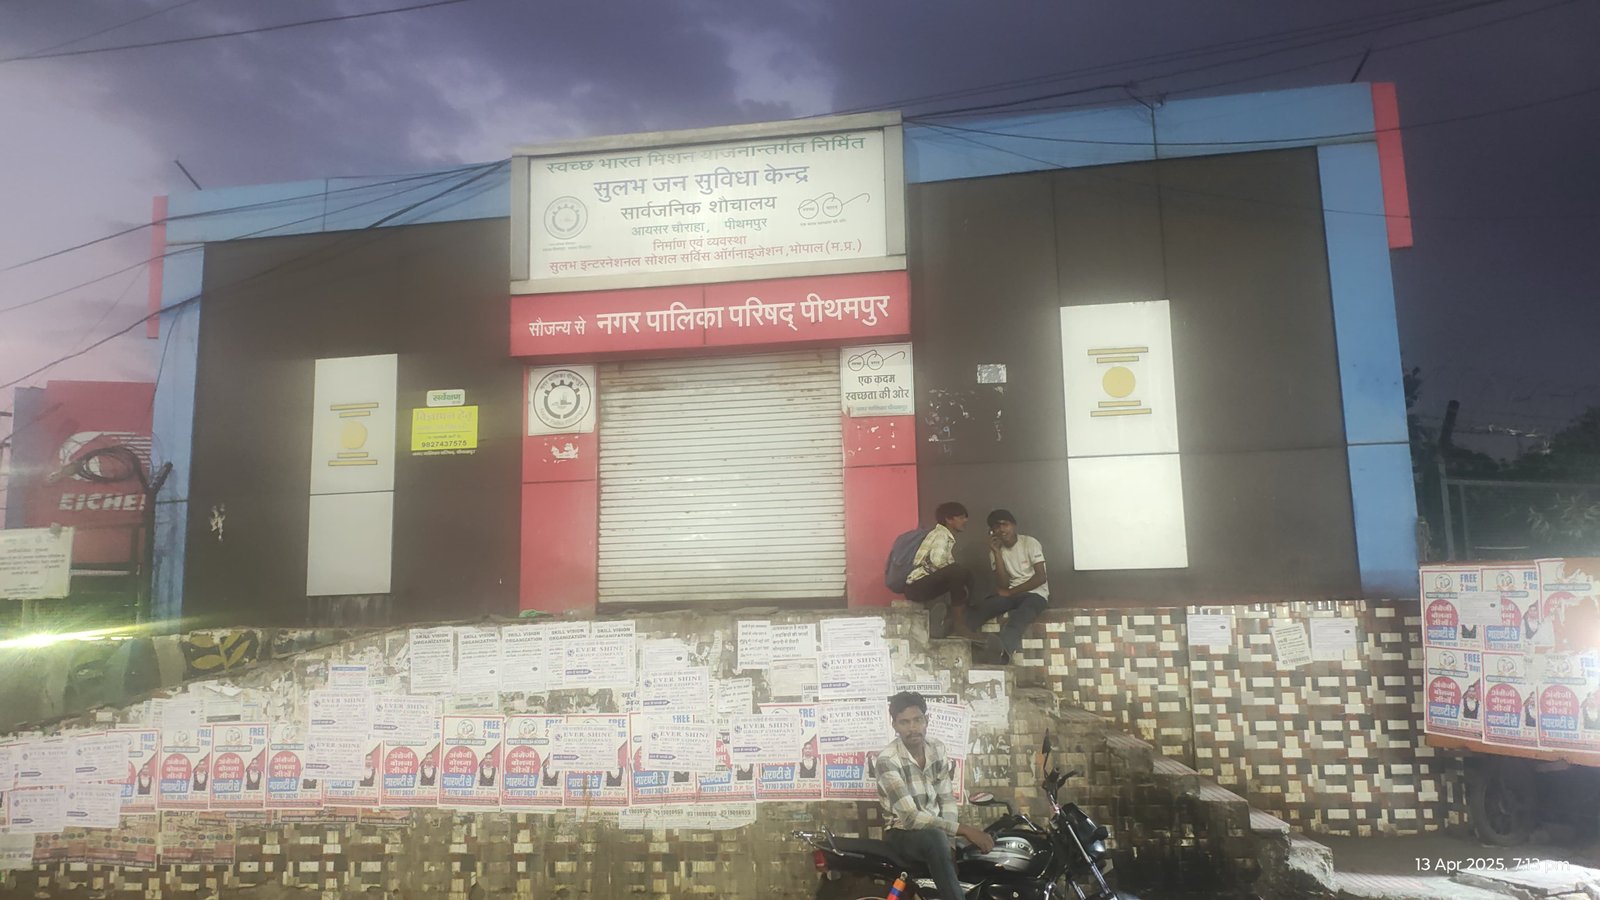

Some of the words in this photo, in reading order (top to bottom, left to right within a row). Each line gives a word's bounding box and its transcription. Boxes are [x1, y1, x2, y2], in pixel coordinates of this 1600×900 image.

[546, 160, 594, 173] स्वच्छ
[599, 156, 643, 170] भारत
[647, 151, 696, 166] मिशन
[811, 135, 866, 152] निर्मित
[593, 179, 647, 203] सुलभ
[652, 175, 689, 192] जन
[694, 167, 760, 195] सुविधा
[764, 163, 810, 184] केन्द्र
[620, 199, 702, 220] सार्वजनिक
[709, 195, 778, 213] शौचालय
[631, 224, 669, 236] आयसर
[725, 217, 768, 231] पीथमपुर
[653, 238, 686, 251] निर्माण
[689, 236, 703, 249] एवं
[706, 236, 747, 247] व्यवस्था
[549, 261, 577, 274] सुलभ
[580, 256, 642, 270] इन्टरनेशनल
[644, 253, 677, 265] सोशल
[680, 250, 711, 263] सर्विस
[528, 317, 572, 336] सौजन्य
[574, 315, 586, 336] से
[596, 311, 642, 335] नगर
[645, 301, 724, 332] पालिका
[728, 296, 798, 331] परिषद्
[800, 292, 890, 327] पीथमपुर
[858, 375, 873, 386] एक
[873, 374, 896, 384] कदम
[845, 391, 877, 400] स्वच्छता
[879, 386, 891, 399] की
[892, 385, 910, 399] ओर
[59, 492, 147, 511] EICHE
[1460, 573, 1478, 583] FREE
[1459, 584, 1465, 592] 2
[830, 657, 853, 665] EVER
[829, 711, 852, 719] EVER
[483, 720, 500, 728] FREE
[249, 727, 265, 736] FREE
[482, 730, 487, 738] 2
[544, 729, 550, 737] 2
[826, 765, 852, 779] गारण्टी
[852, 766, 860, 779] से
